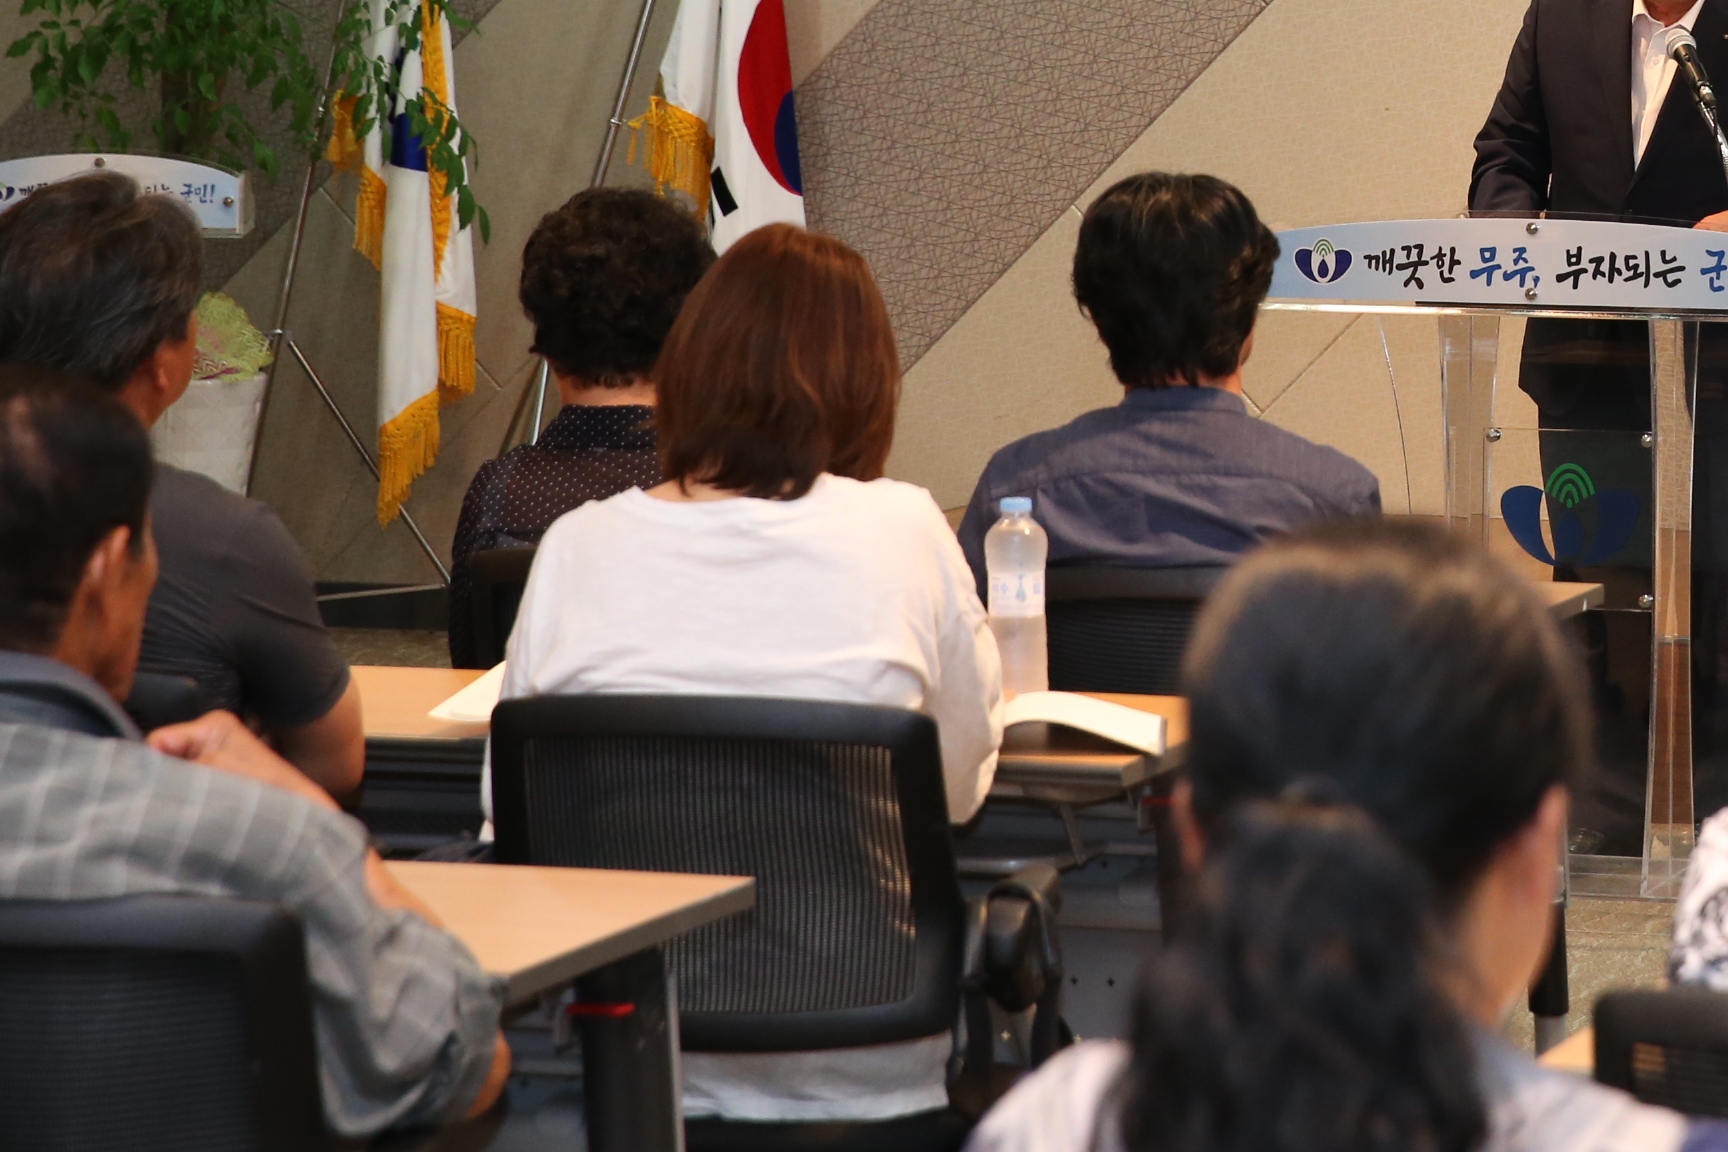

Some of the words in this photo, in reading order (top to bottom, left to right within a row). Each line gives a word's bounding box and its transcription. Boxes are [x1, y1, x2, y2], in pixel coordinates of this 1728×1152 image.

[1363, 243, 1462, 290] 깨끗한
[1469, 246, 1541, 289] 무주,
[1555, 246, 1687, 290] 부자되는
